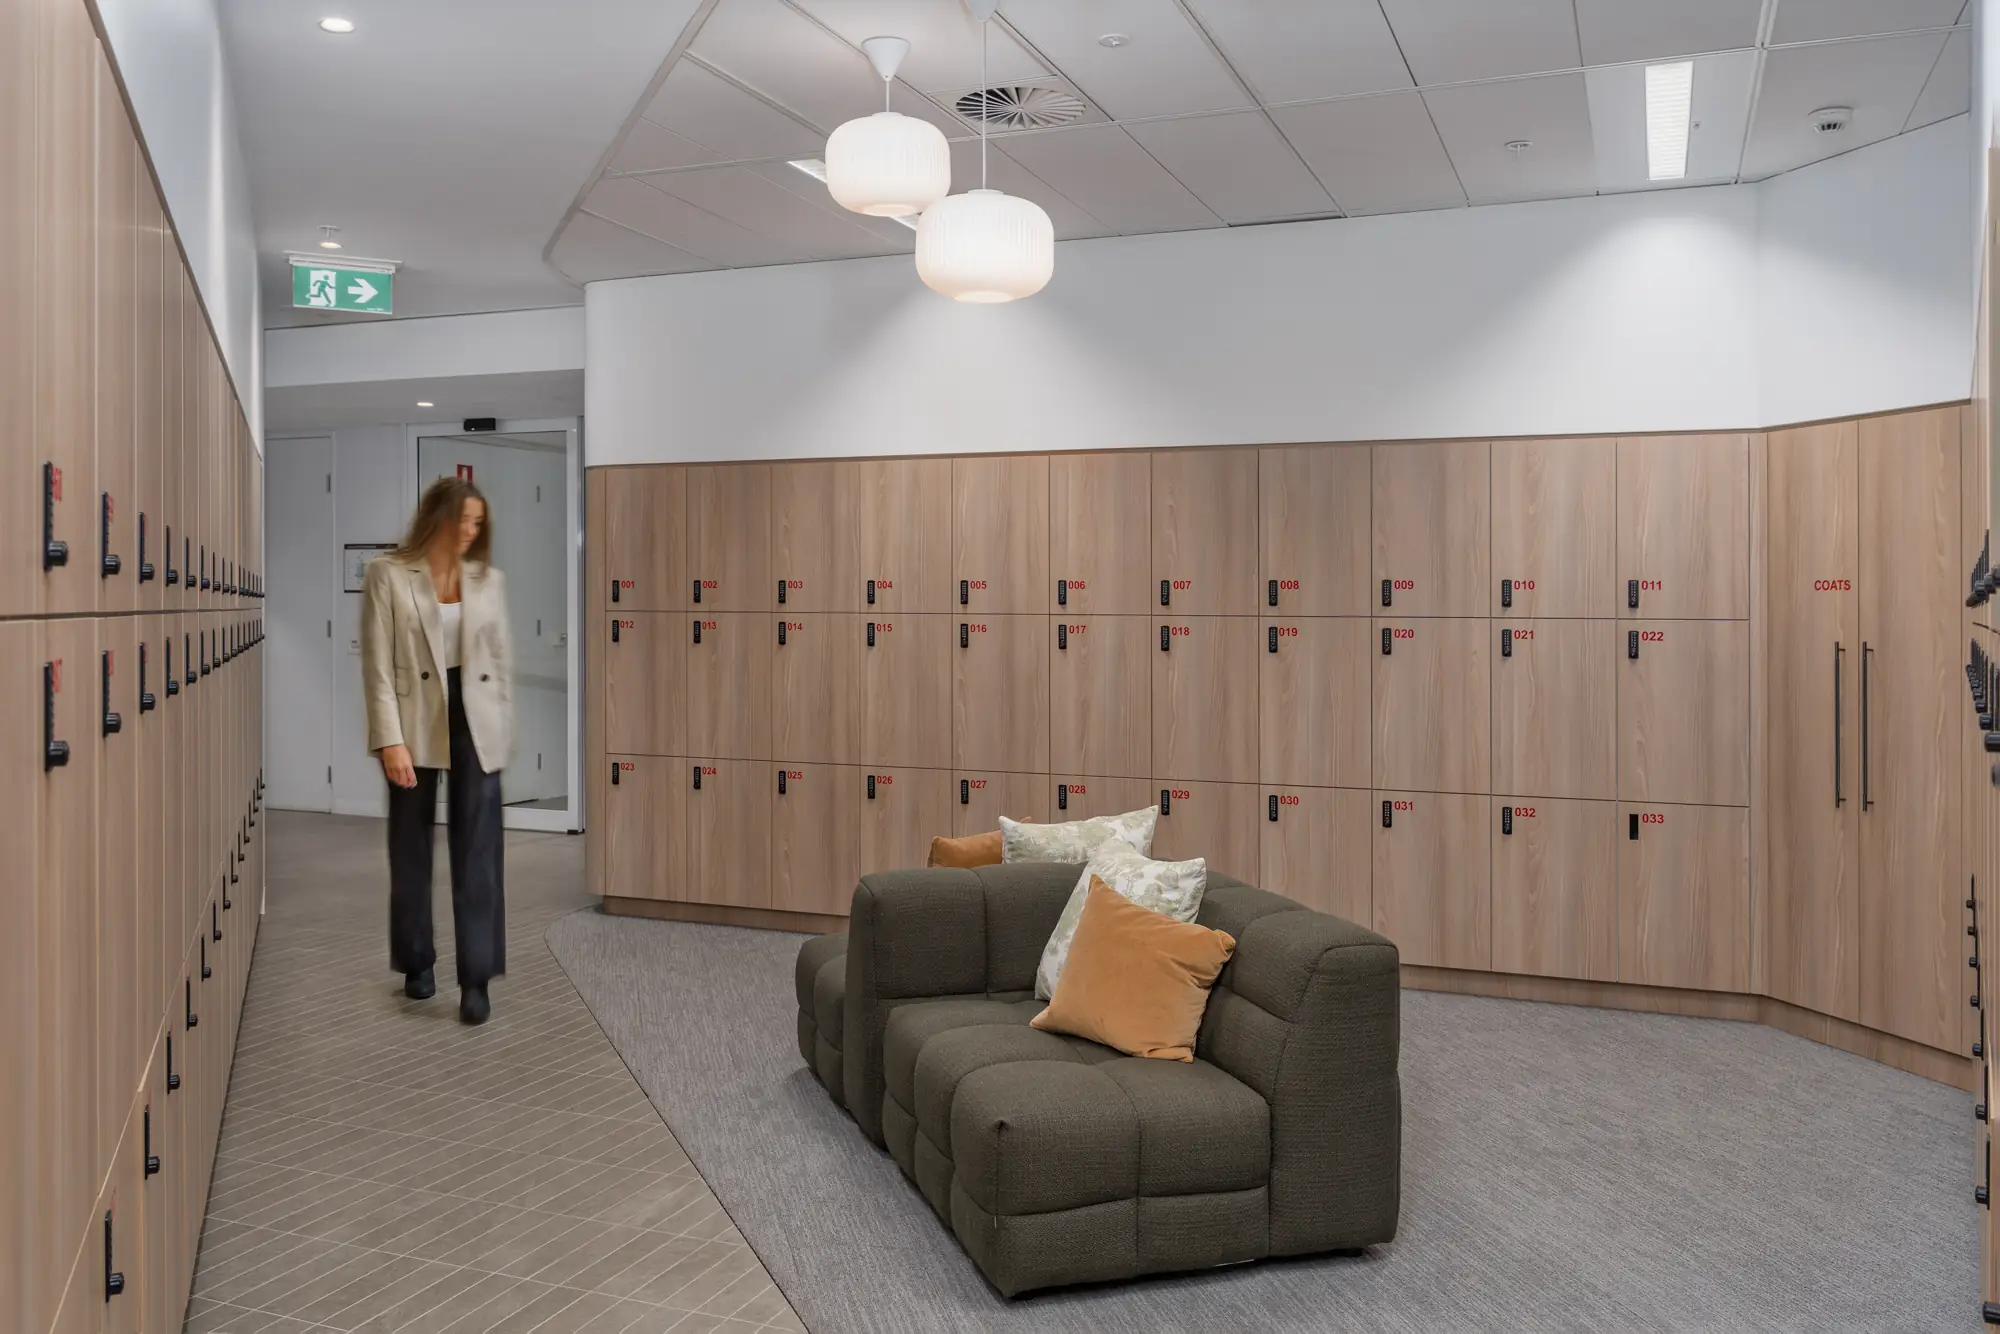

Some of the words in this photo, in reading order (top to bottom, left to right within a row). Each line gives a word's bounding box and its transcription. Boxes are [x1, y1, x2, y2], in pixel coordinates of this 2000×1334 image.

[621, 581, 635, 589] 001
[702, 580, 718, 589] 002
[788, 580, 803, 589] 003
[877, 580, 893, 589] 004
[970, 580, 987, 589] 005
[1068, 580, 1086, 589] 006
[1173, 580, 1191, 590] 007
[1280, 580, 1300, 590] 008
[1394, 580, 1414, 590] 009
[1513, 580, 1535, 590] 010
[1641, 580, 1662, 591] 011
[1814, 580, 1851, 591] COATS
[620, 620, 634, 629] 012
[702, 621, 717, 630] 013
[787, 623, 802, 631] 014
[876, 624, 892, 632] 015
[970, 624, 987, 633] 016
[1069, 625, 1087, 634] 017
[1171, 626, 1190, 636] 018
[1278, 627, 1298, 637] 019
[1394, 629, 1414, 639] 020
[1513, 629, 1535, 640] 021
[1641, 631, 1663, 641] 022
[621, 762, 635, 771] 023
[702, 767, 717, 775] 024
[787, 771, 803, 780] 025
[877, 776, 893, 785] 026
[970, 780, 987, 789] 027
[1069, 785, 1086, 794] 028
[1171, 789, 1190, 800] 029
[1280, 795, 1299, 806] 030
[1394, 801, 1414, 811] 031
[1514, 807, 1536, 818] 032
[1642, 813, 1664, 824] 033
